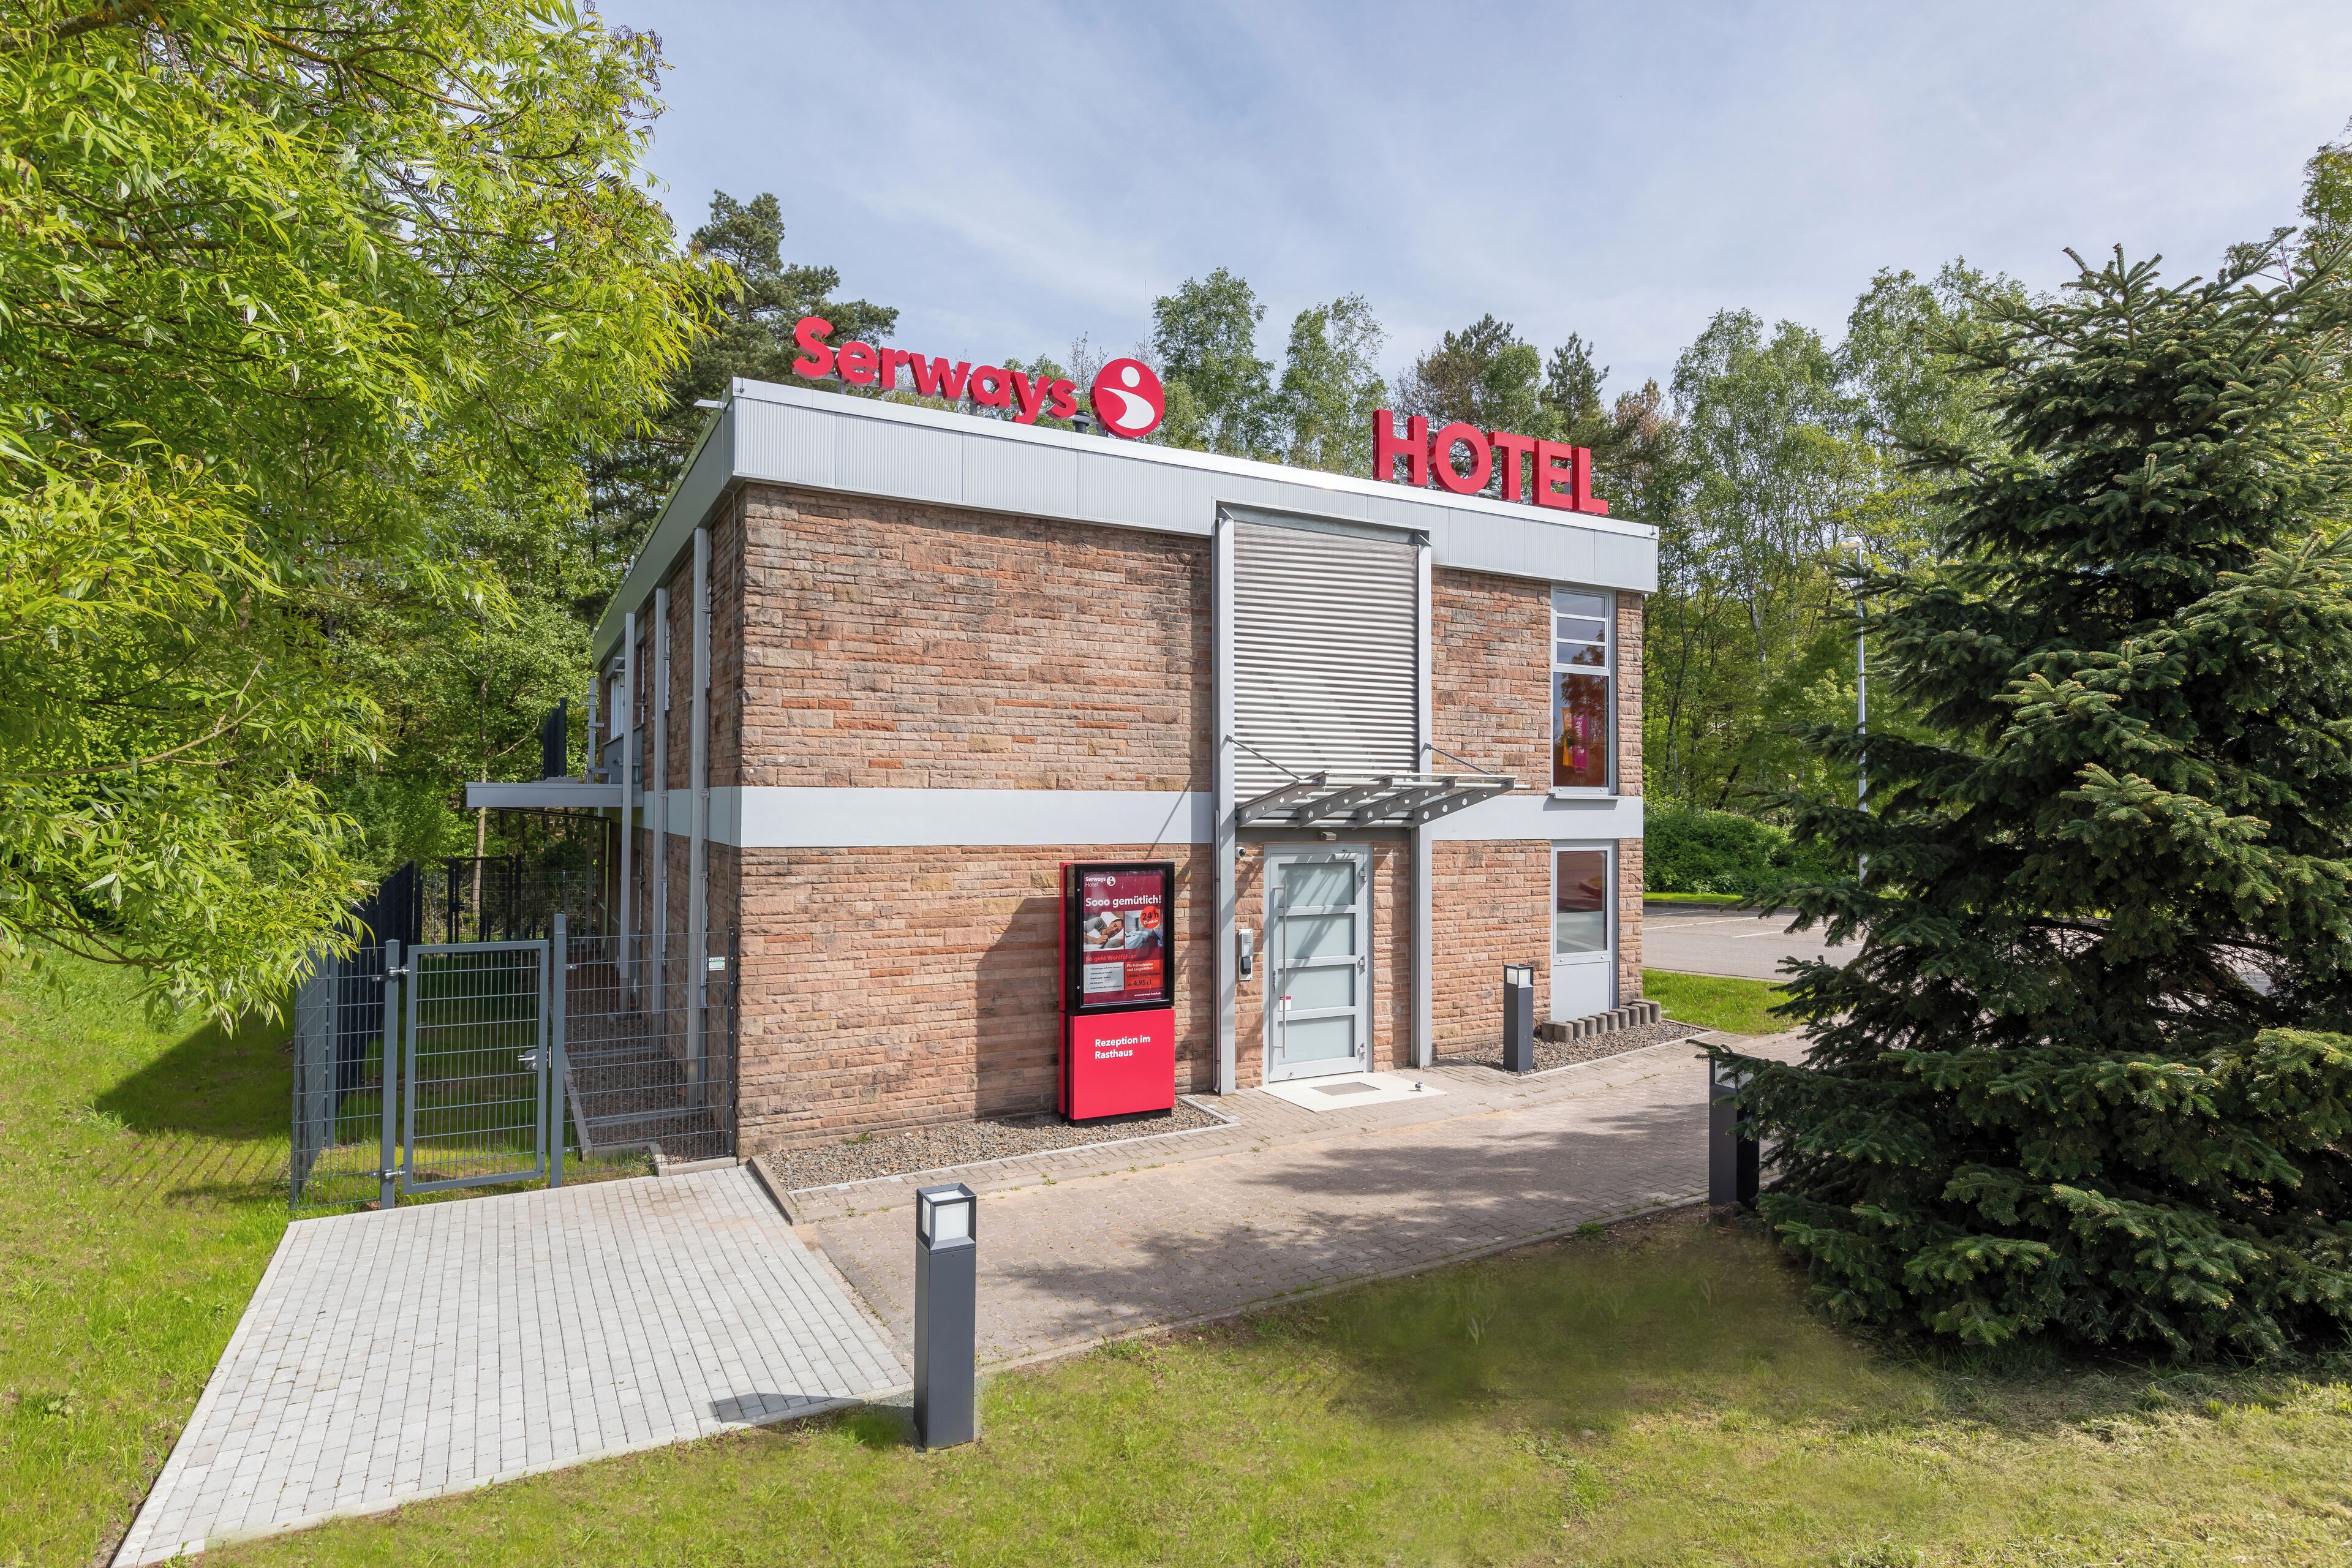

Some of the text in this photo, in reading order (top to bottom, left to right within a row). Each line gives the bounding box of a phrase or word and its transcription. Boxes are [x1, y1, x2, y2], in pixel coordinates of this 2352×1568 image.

[793, 317, 1077, 425] Serways
[1373, 409, 1608, 515] HOTEL
[1085, 895, 1161, 908] Sooo gemütlich!
[1095, 1035, 1150, 1047] Rezeption im
[1095, 1049, 1133, 1060] Rasthaus
